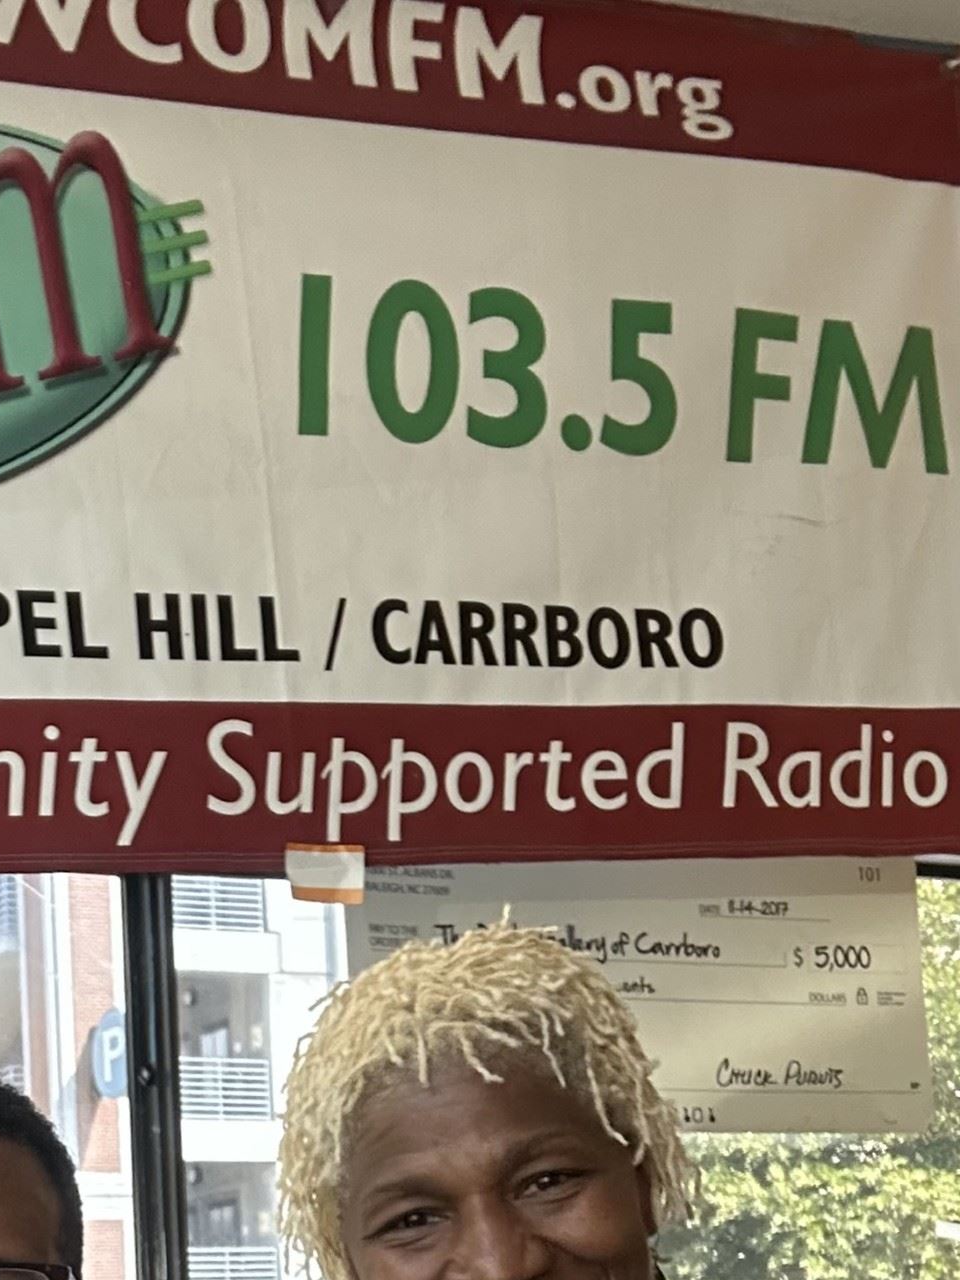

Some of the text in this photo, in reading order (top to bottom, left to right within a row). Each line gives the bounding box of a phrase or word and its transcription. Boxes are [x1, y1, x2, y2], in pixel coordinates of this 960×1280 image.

[298, 273, 949, 475] 103.5 FM
[134, 592, 300, 662] HILL
[324, 597, 347, 671] /
[372, 598, 724, 669] CARRBORO
[206, 719, 685, 841] Supported
[722, 721, 949, 809] Radio
[858, 866, 881, 883] 101
[611, 931, 630, 957] of
[634, 932, 721, 958] Carrboro
[793, 945, 872, 973] $ 5,000
[101, 1026, 126, 1083] P
